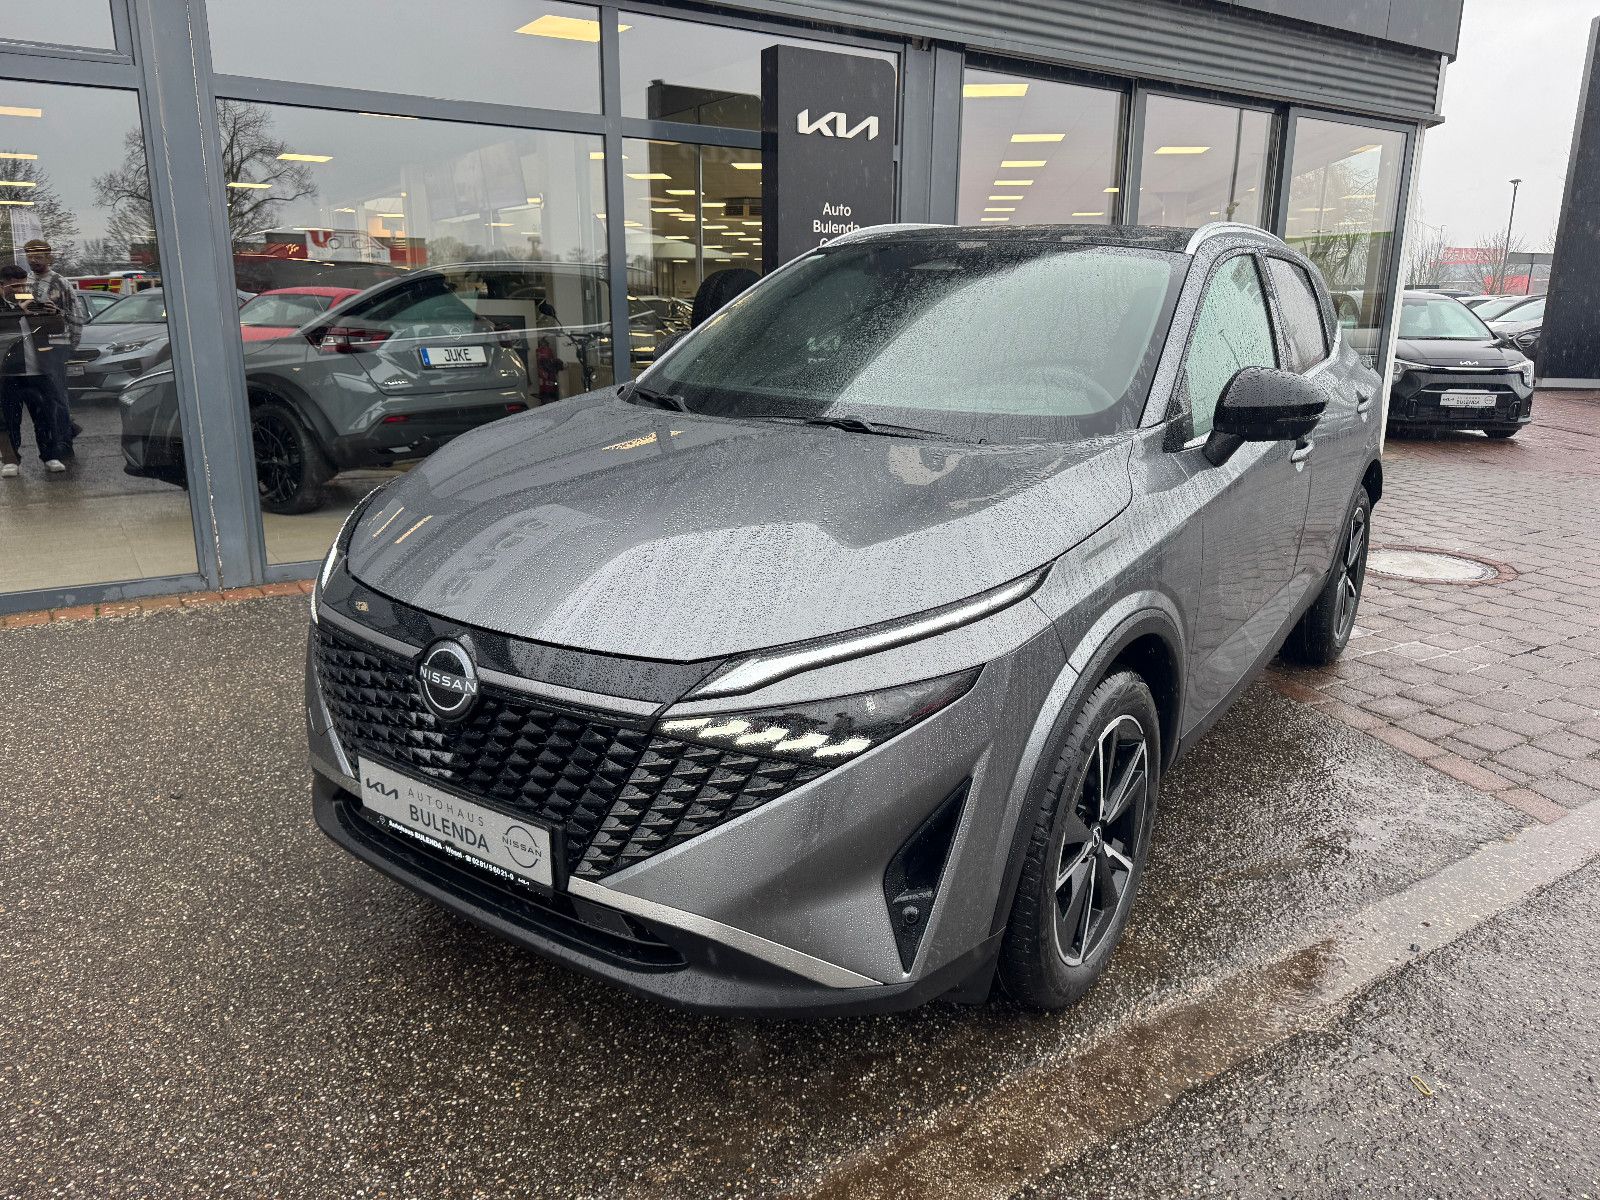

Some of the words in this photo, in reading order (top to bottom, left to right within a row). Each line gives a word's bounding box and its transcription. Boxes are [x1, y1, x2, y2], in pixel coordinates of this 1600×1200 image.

[797, 109, 879, 141] KIA
[822, 202, 852, 217] Auto
[813, 219, 861, 234] Bulenda
[444, 348, 472, 362] JUKE
[420, 665, 477, 693] NISSAN
[366, 777, 398, 800] KIA
[408, 787, 484, 827] AUTOHAUS
[409, 804, 490, 853] BULENDA
[414, 831, 443, 850] BULENDA
[501, 836, 542, 858] NISSAN
